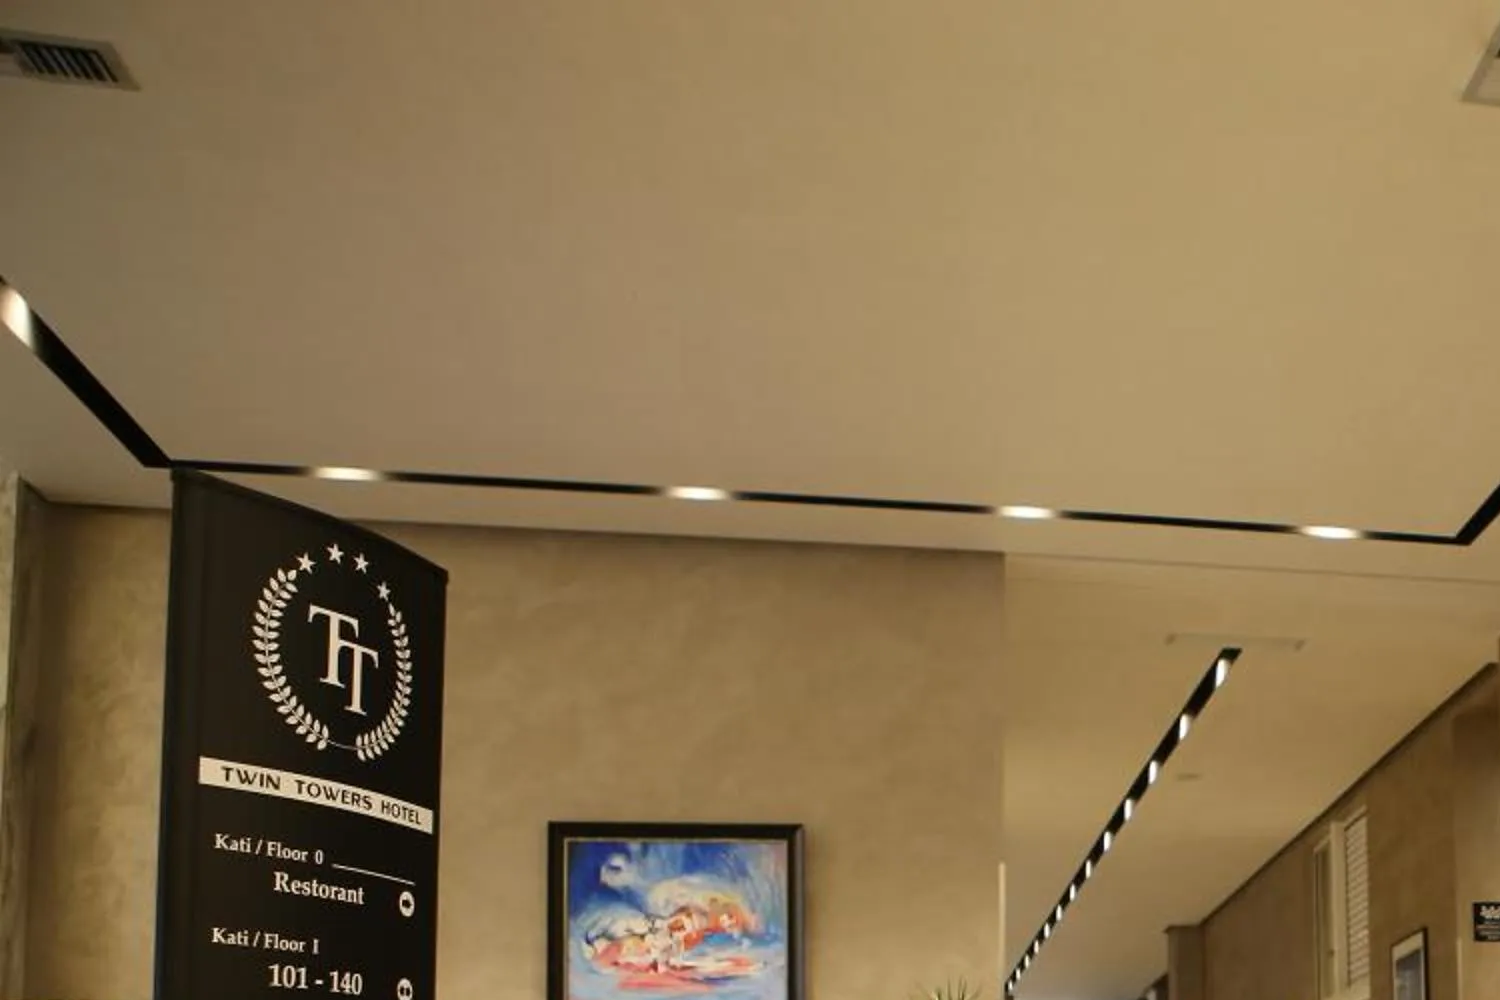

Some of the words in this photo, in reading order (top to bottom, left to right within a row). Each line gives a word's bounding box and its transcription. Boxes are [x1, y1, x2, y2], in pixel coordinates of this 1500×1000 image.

[221, 766, 281, 791] TWIN
[295, 779, 373, 811] TOWERS
[381, 801, 422, 825] HOTEL
[214, 833, 251, 852] Kati
[267, 841, 309, 863] Floor
[314, 849, 324, 865] 0
[273, 871, 365, 905] Restorant
[211, 927, 249, 947] Kati
[263, 933, 306, 953] Floor
[312, 938, 320, 955] I
[268, 963, 308, 989] 101
[329, 970, 363, 995] 140
